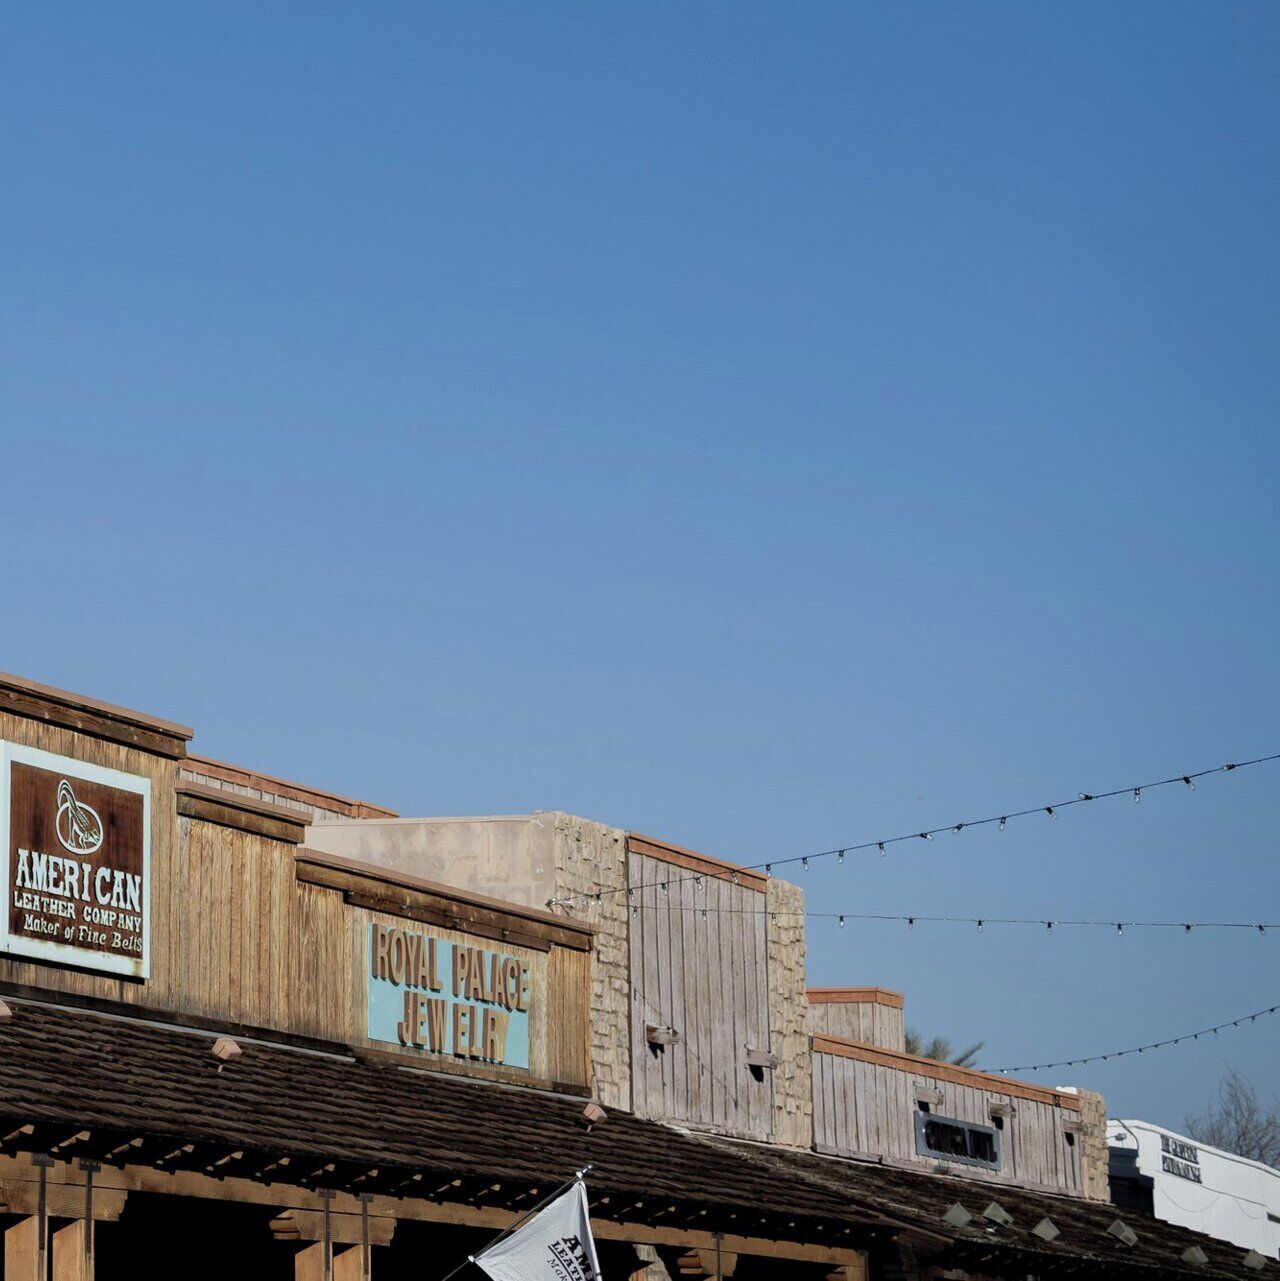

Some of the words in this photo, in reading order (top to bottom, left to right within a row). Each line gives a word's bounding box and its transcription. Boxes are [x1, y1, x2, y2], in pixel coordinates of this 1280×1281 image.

[14, 890, 76, 920] LEATHER
[83, 907, 143, 933] COMPANY
[15, 847, 142, 913] AMERICAN
[24, 913, 60, 936] Maker
[65, 926, 75, 943] of
[79, 927, 107, 946] Fine
[371, 923, 443, 993] ROYAL
[452, 944, 530, 1014] PALACE
[397, 990, 509, 1063] JEWELRY
